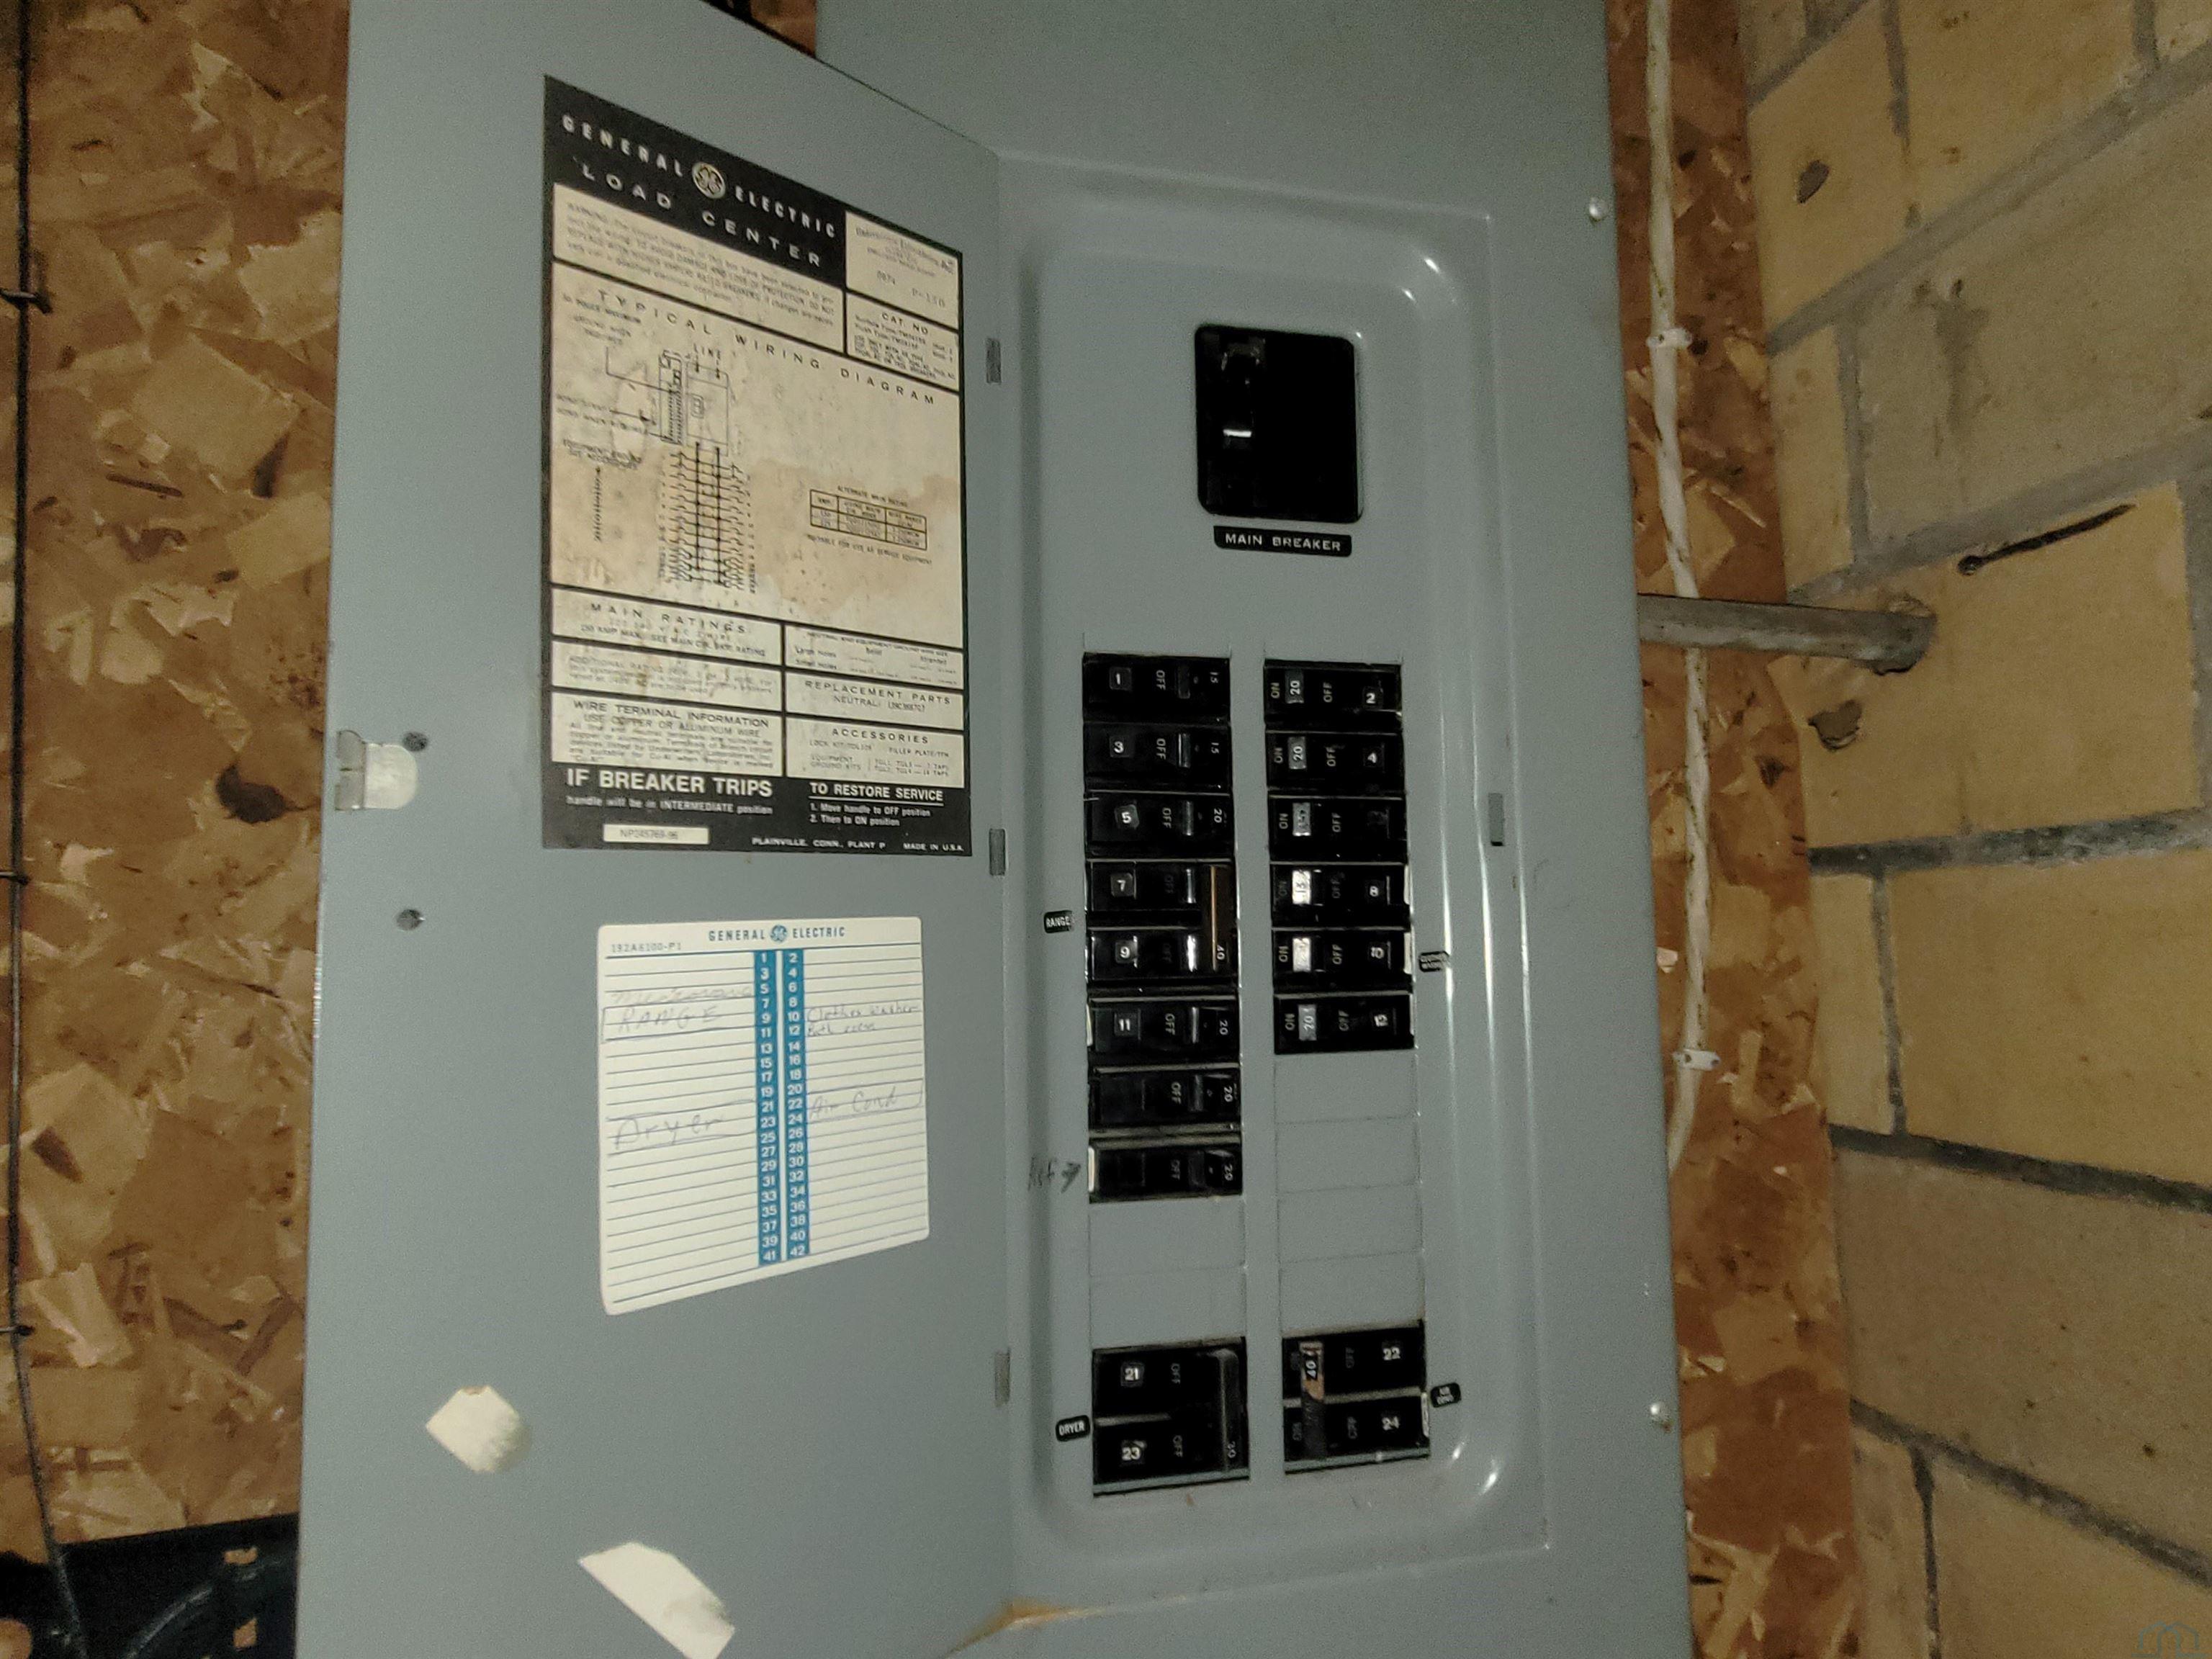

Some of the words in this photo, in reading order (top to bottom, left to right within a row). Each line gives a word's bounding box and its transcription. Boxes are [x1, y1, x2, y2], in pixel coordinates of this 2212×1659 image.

[562, 114, 683, 178] GENERAL
[735, 184, 835, 239] ELECTRIC
[582, 163, 670, 211] LOAD
[703, 210, 820, 267] CENTER
[598, 289, 711, 335] TYPICAL
[735, 333, 819, 369] WIRING
[840, 368, 934, 405] DIAGRAM
[693, 343, 721, 359] LINE
[1225, 533, 1263, 546] MAIN
[1272, 536, 1342, 552] BREAKER
[590, 603, 642, 618] MAIN
[662, 613, 746, 633] RATINGS
[1115, 673, 1121, 685] 1
[1156, 670, 1166, 691] OFF
[1210, 671, 1218, 683] 15
[805, 680, 902, 699] REPLACEMENT
[912, 693, 950, 705] PARTS
[1271, 683, 1280, 698] ON
[1290, 680, 1300, 696] 20
[1323, 682, 1333, 703] OFF
[1366, 693, 1376, 704] 2
[573, 701, 607, 712] WIRE
[616, 705, 679, 719] TERMINAL
[688, 711, 768, 727] INFORMATION
[658, 721, 673, 729] OR
[737, 728, 760, 737] WIRE
[832, 728, 928, 743] ACCESSORIES
[1114, 741, 1124, 753] 3
[1156, 738, 1166, 760] OFF
[1211, 742, 1220, 754] 15
[1292, 746, 1303, 761] 20
[1274, 747, 1283, 763] ON
[1326, 747, 1336, 767] OFF
[1367, 752, 1377, 763] 4
[567, 768, 589, 787] IF
[599, 770, 705, 793] BREAKER
[711, 777, 773, 796] TRIPS
[809, 783, 827, 794] TO
[834, 784, 889, 798] RESTORE
[896, 788, 943, 801] SERVICE
[566, 796, 602, 806] handle
[606, 798, 625, 807] will
[629, 799, 642, 808] be
[660, 800, 734, 812] INTERMEDIATE
[737, 804, 773, 814] position
[820, 804, 840, 812] Move
[844, 804, 870, 814] handle
[873, 806, 881, 814] to
[884, 806, 898, 815] OFF
[902, 807, 930, 817] position
[821, 815, 840, 824] Then
[870, 817, 899, 826] position
[1121, 811, 1131, 824] 5
[1162, 807, 1172, 828] OFF
[1214, 809, 1223, 823] 20
[1279, 813, 1288, 829] ON
[1332, 812, 1341, 832] OFF
[1117, 879, 1126, 891] 7
[1370, 886, 1379, 897] 8
[1046, 916, 1071, 927] RANGE
[708, 930, 766, 942] GENERAL
[792, 926, 845, 939] ELECTRIC
[760, 952, 768, 963] 1
[788, 952, 798, 963] 2
[1120, 945, 1130, 958] 9
[1279, 946, 1289, 962] ON
[1332, 945, 1343, 964] OFF
[760, 967, 770, 980] 3
[788, 967, 798, 978] 4
[760, 983, 770, 994] 5
[788, 981, 798, 993] 6
[761, 997, 770, 1009] 7
[788, 997, 798, 1008] 8
[761, 1012, 772, 1024] 9
[788, 1010, 801, 1022] 10
[1285, 1013, 1295, 1030] ON
[1339, 1010, 1349, 1031] OFF
[788, 1024, 801, 1035] 12
[1119, 1018, 1131, 1031] 11
[1165, 1013, 1175, 1035] OFF
[1219, 1020, 1228, 1035] 20
[1304, 1015, 1314, 1031] 20
[760, 1027, 772, 1038] 11
[760, 1042, 773, 1054] 13
[788, 1040, 801, 1051] 14
[760, 1057, 773, 1069] 15
[761, 1070, 773, 1082] 17
[760, 1086, 774, 1097] 19
[787, 1083, 804, 1095] 20
[1171, 1082, 1182, 1105] OFF
[1224, 1086, 1233, 1102] 20
[762, 1100, 774, 1112] 21
[788, 1097, 803, 1110] 22
[760, 1115, 776, 1128] 23
[788, 1112, 804, 1125] 24
[760, 1130, 776, 1143] 25
[788, 1126, 804, 1139] 26
[761, 1145, 776, 1158] 27
[761, 1159, 777, 1172] 29
[788, 1155, 805, 1168] 30
[789, 1169, 804, 1182] 32
[1224, 1164, 1233, 1182] 20
[763, 1174, 775, 1187] 31
[761, 1190, 777, 1203] 33
[790, 1184, 806, 1198] 34
[762, 1205, 778, 1218] 35
[790, 1200, 806, 1213] 36
[763, 1219, 777, 1233] 37
[790, 1214, 806, 1227] 38
[762, 1235, 778, 1248] 39
[790, 1229, 806, 1241] 40
[763, 1250, 776, 1262] 41
[790, 1244, 808, 1257] 42
[1382, 1346, 1401, 1360] 22
[1125, 1367, 1139, 1381] 21
[1058, 1420, 1085, 1436] DRYER
[1381, 1416, 1401, 1431] 24
[1122, 1447, 1141, 1461] 23
